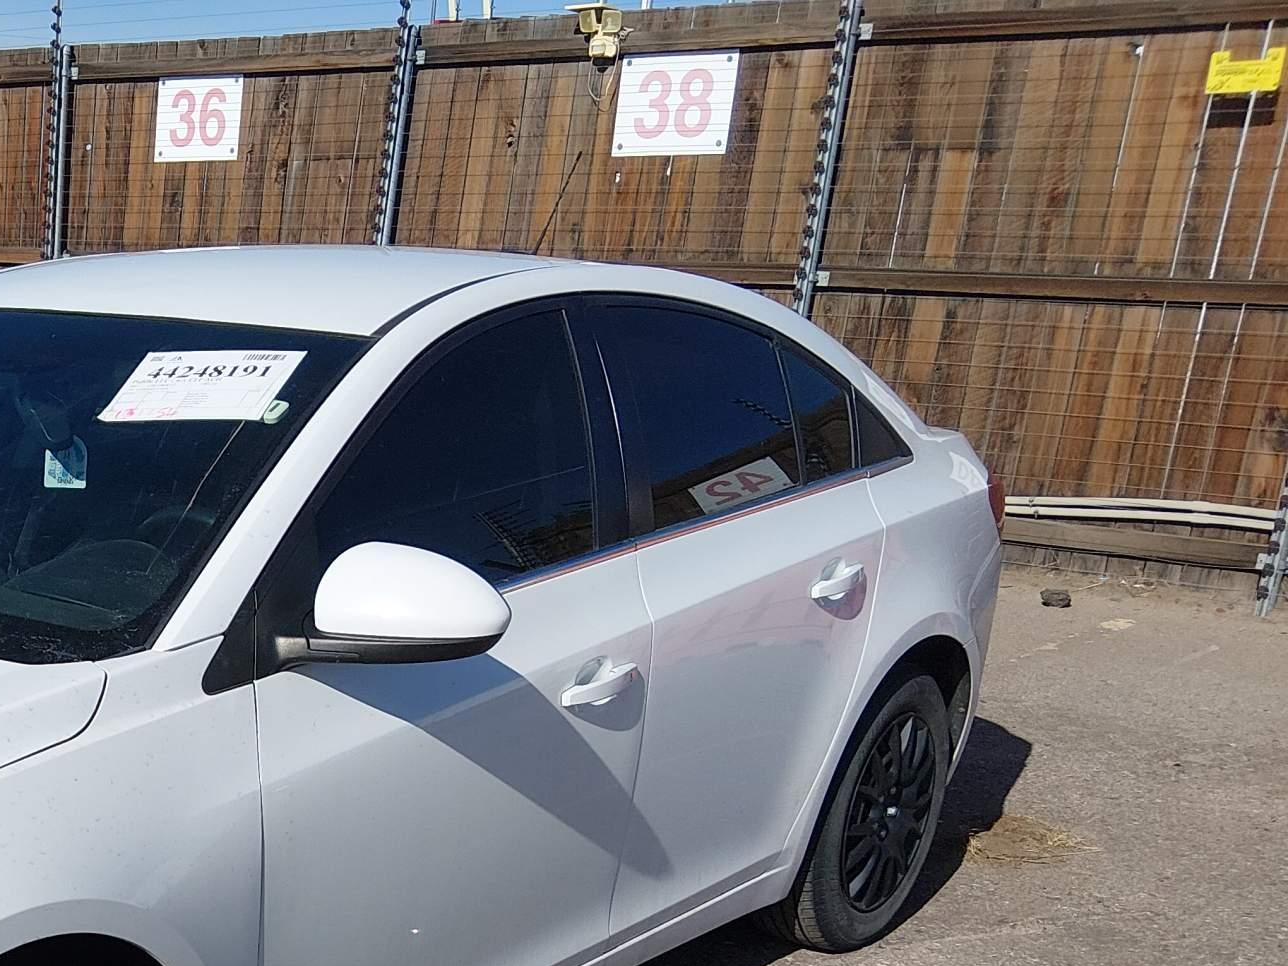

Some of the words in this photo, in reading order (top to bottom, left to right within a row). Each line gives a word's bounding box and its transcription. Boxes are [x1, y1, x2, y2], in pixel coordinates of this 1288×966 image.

[169, 88, 227, 147] 36
[633, 68, 714, 139] 38
[147, 365, 273, 379] 44248191
